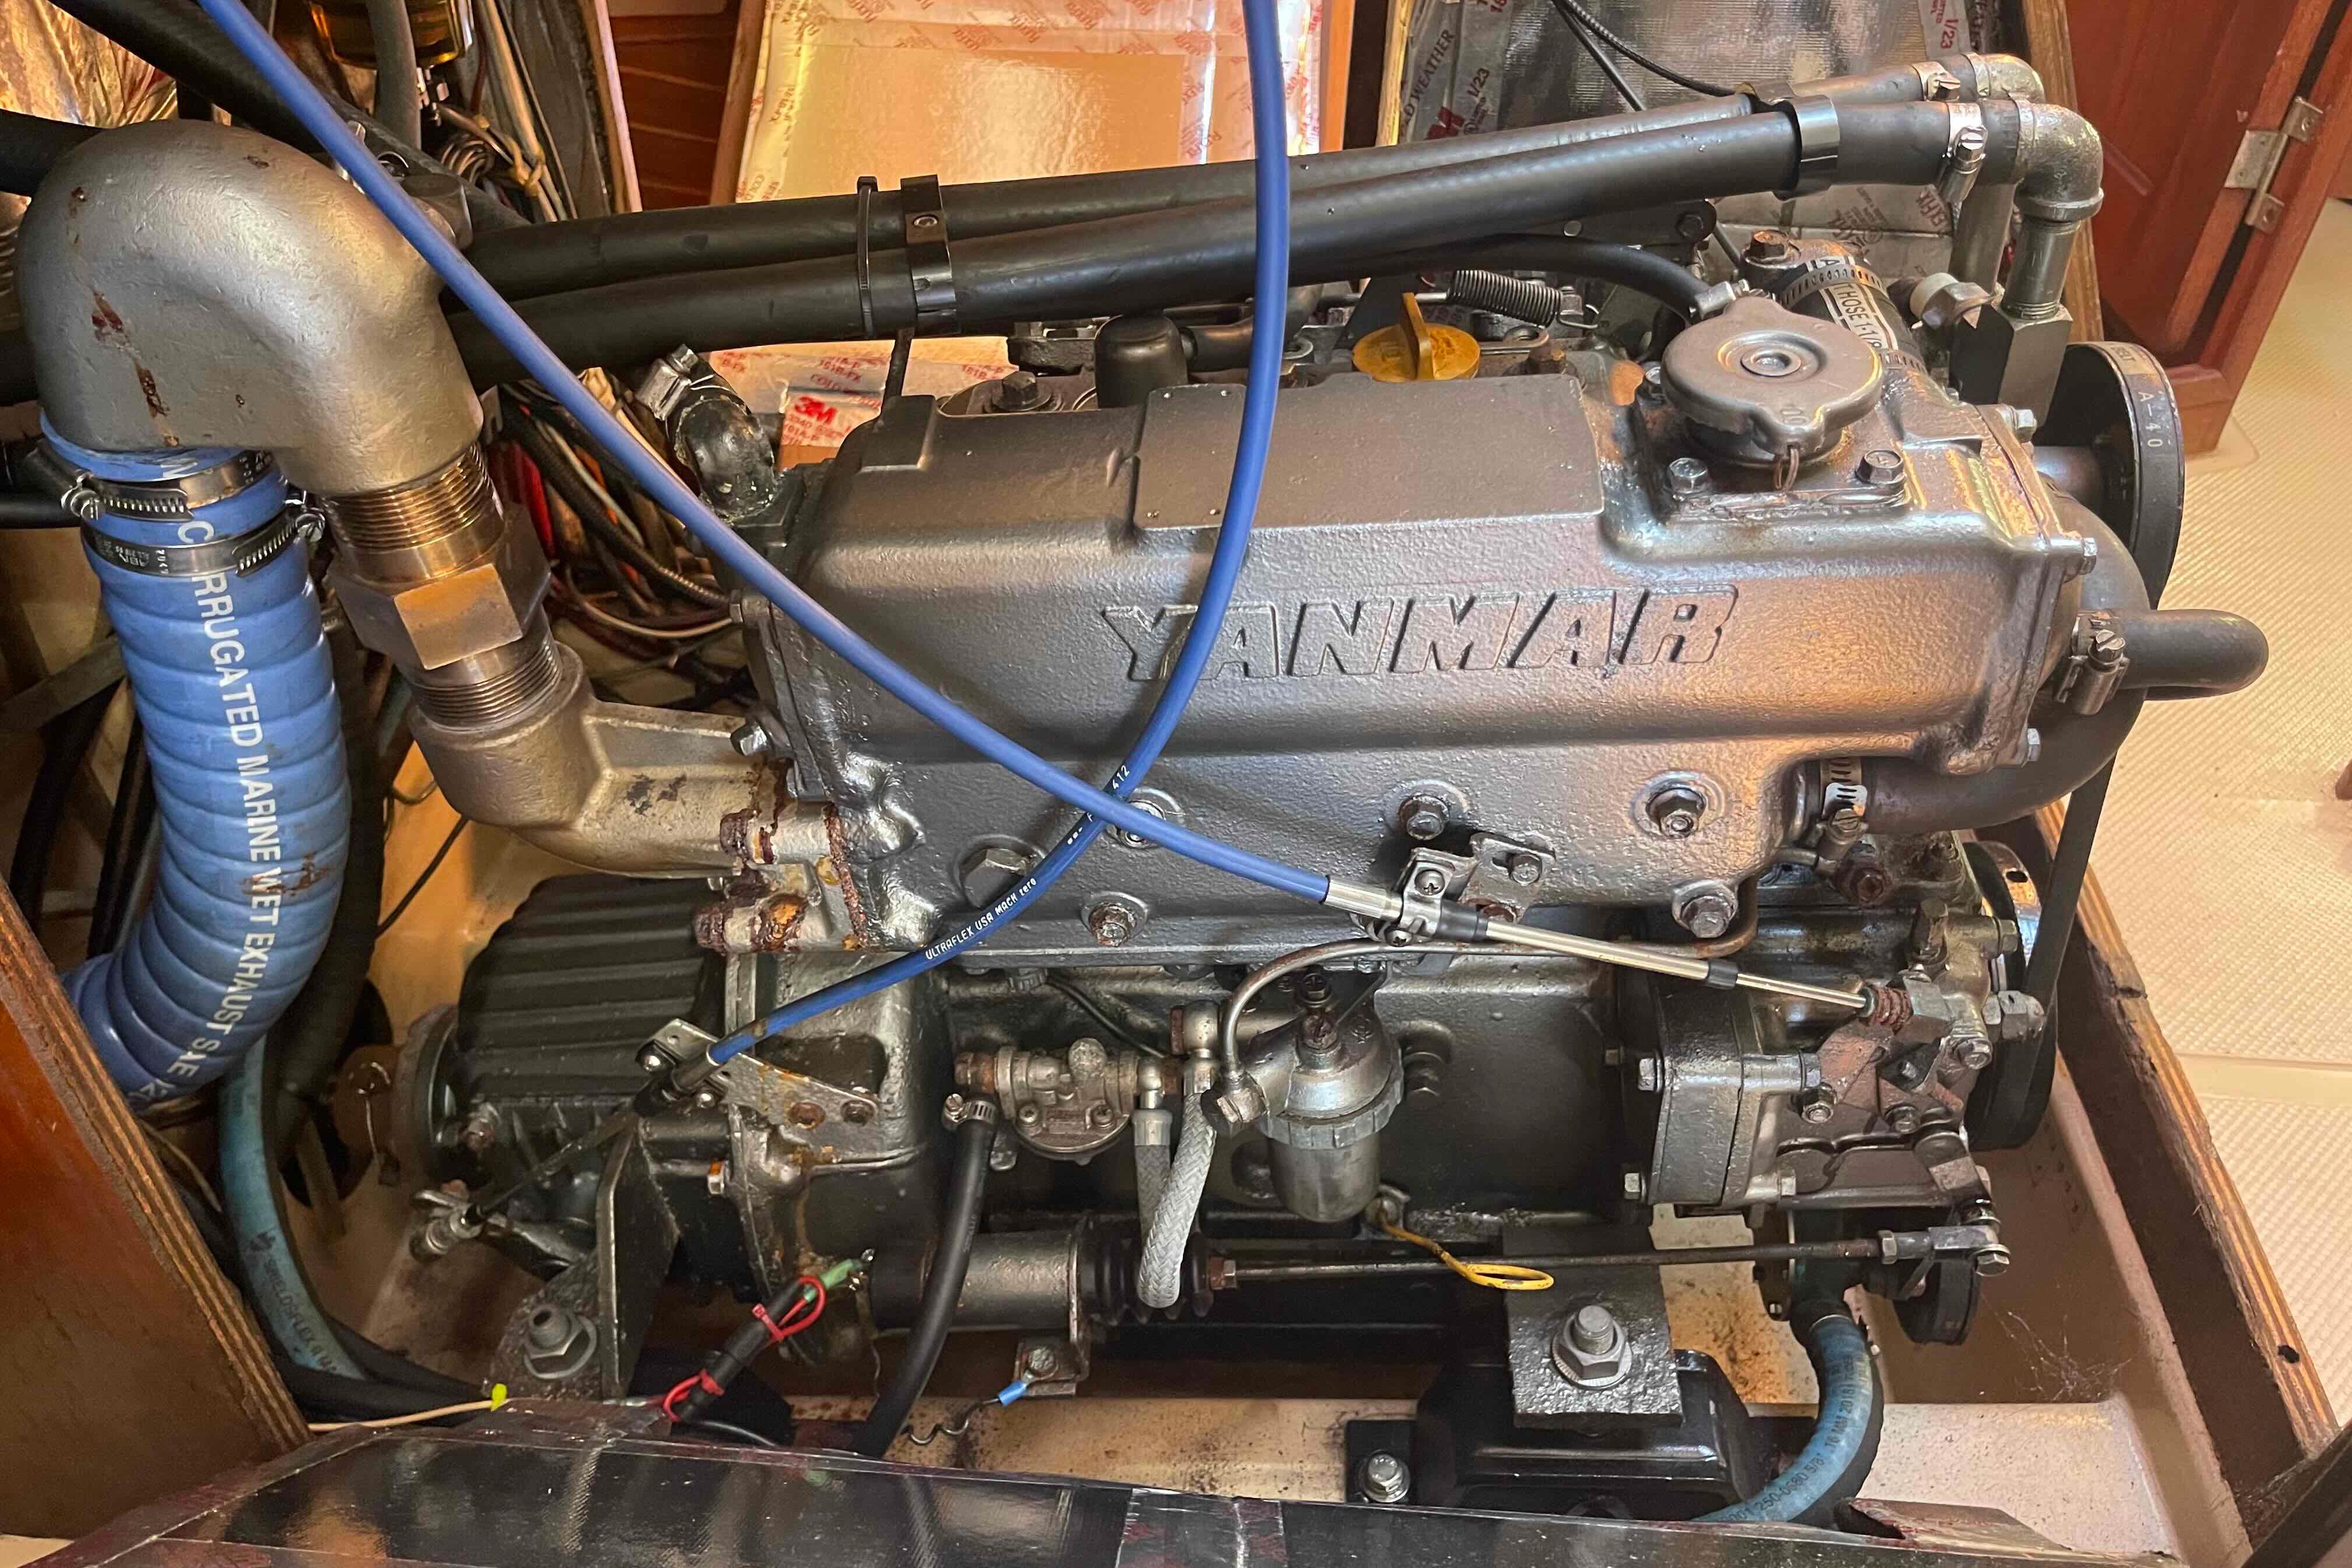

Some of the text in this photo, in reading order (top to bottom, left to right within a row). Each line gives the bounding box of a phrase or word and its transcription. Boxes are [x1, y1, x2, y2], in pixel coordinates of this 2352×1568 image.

[1410, 30, 1455, 102] WEATHER
[1941, 19, 1959, 48] 1/23
[1466, 67, 1490, 98] 1/23
[1838, 290, 1869, 321] HOSE
[794, 396, 838, 425] 3M
[177, 520, 264, 747] CRRUGATED
[1101, 584, 1738, 681] YANMAR
[236, 755, 281, 862] MARINE
[250, 867, 281, 926] WET
[925, 925, 974, 960] ULTRAFLEX
[975, 912, 994, 931] USA
[995, 895, 1019, 916] MACH
[205, 933, 275, 1035] EXHAUST
